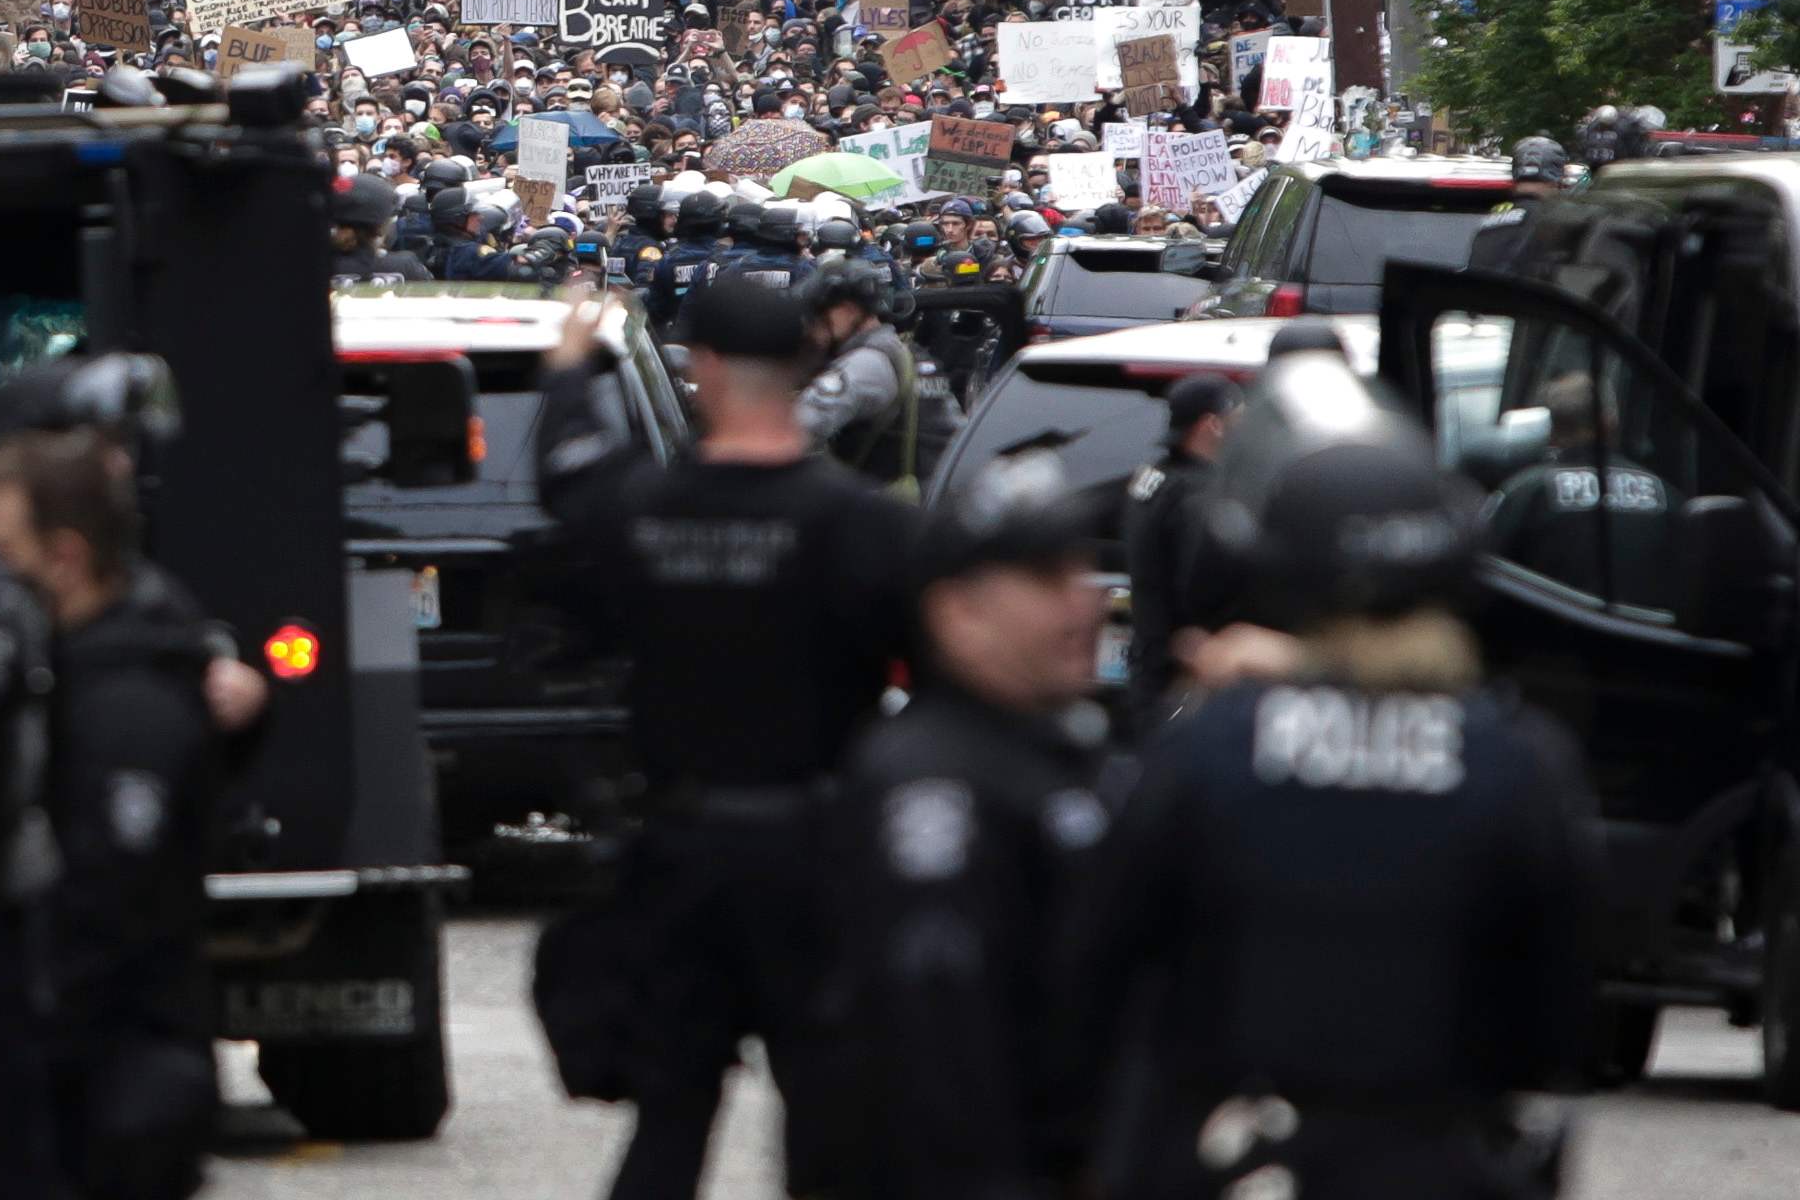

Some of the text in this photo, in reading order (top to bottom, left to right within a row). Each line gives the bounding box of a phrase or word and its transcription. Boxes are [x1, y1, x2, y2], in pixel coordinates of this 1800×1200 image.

[199, 9, 266, 30] ERIC GARNER
[226, 5, 249, 17] RICE
[1053, 6, 1096, 22] GEO
[1146, 9, 1187, 31] YOUR
[1724, 4, 1735, 21] 2
[592, 14, 667, 47] BREATHE
[227, 38, 277, 63] BLUE
[1171, 134, 1224, 157] POLICE
[1175, 150, 1228, 173] REFORM
[587, 165, 650, 181] WHY ARE THE
[1182, 166, 1229, 190] NOW
[1253, 686, 1464, 794] POLICE
